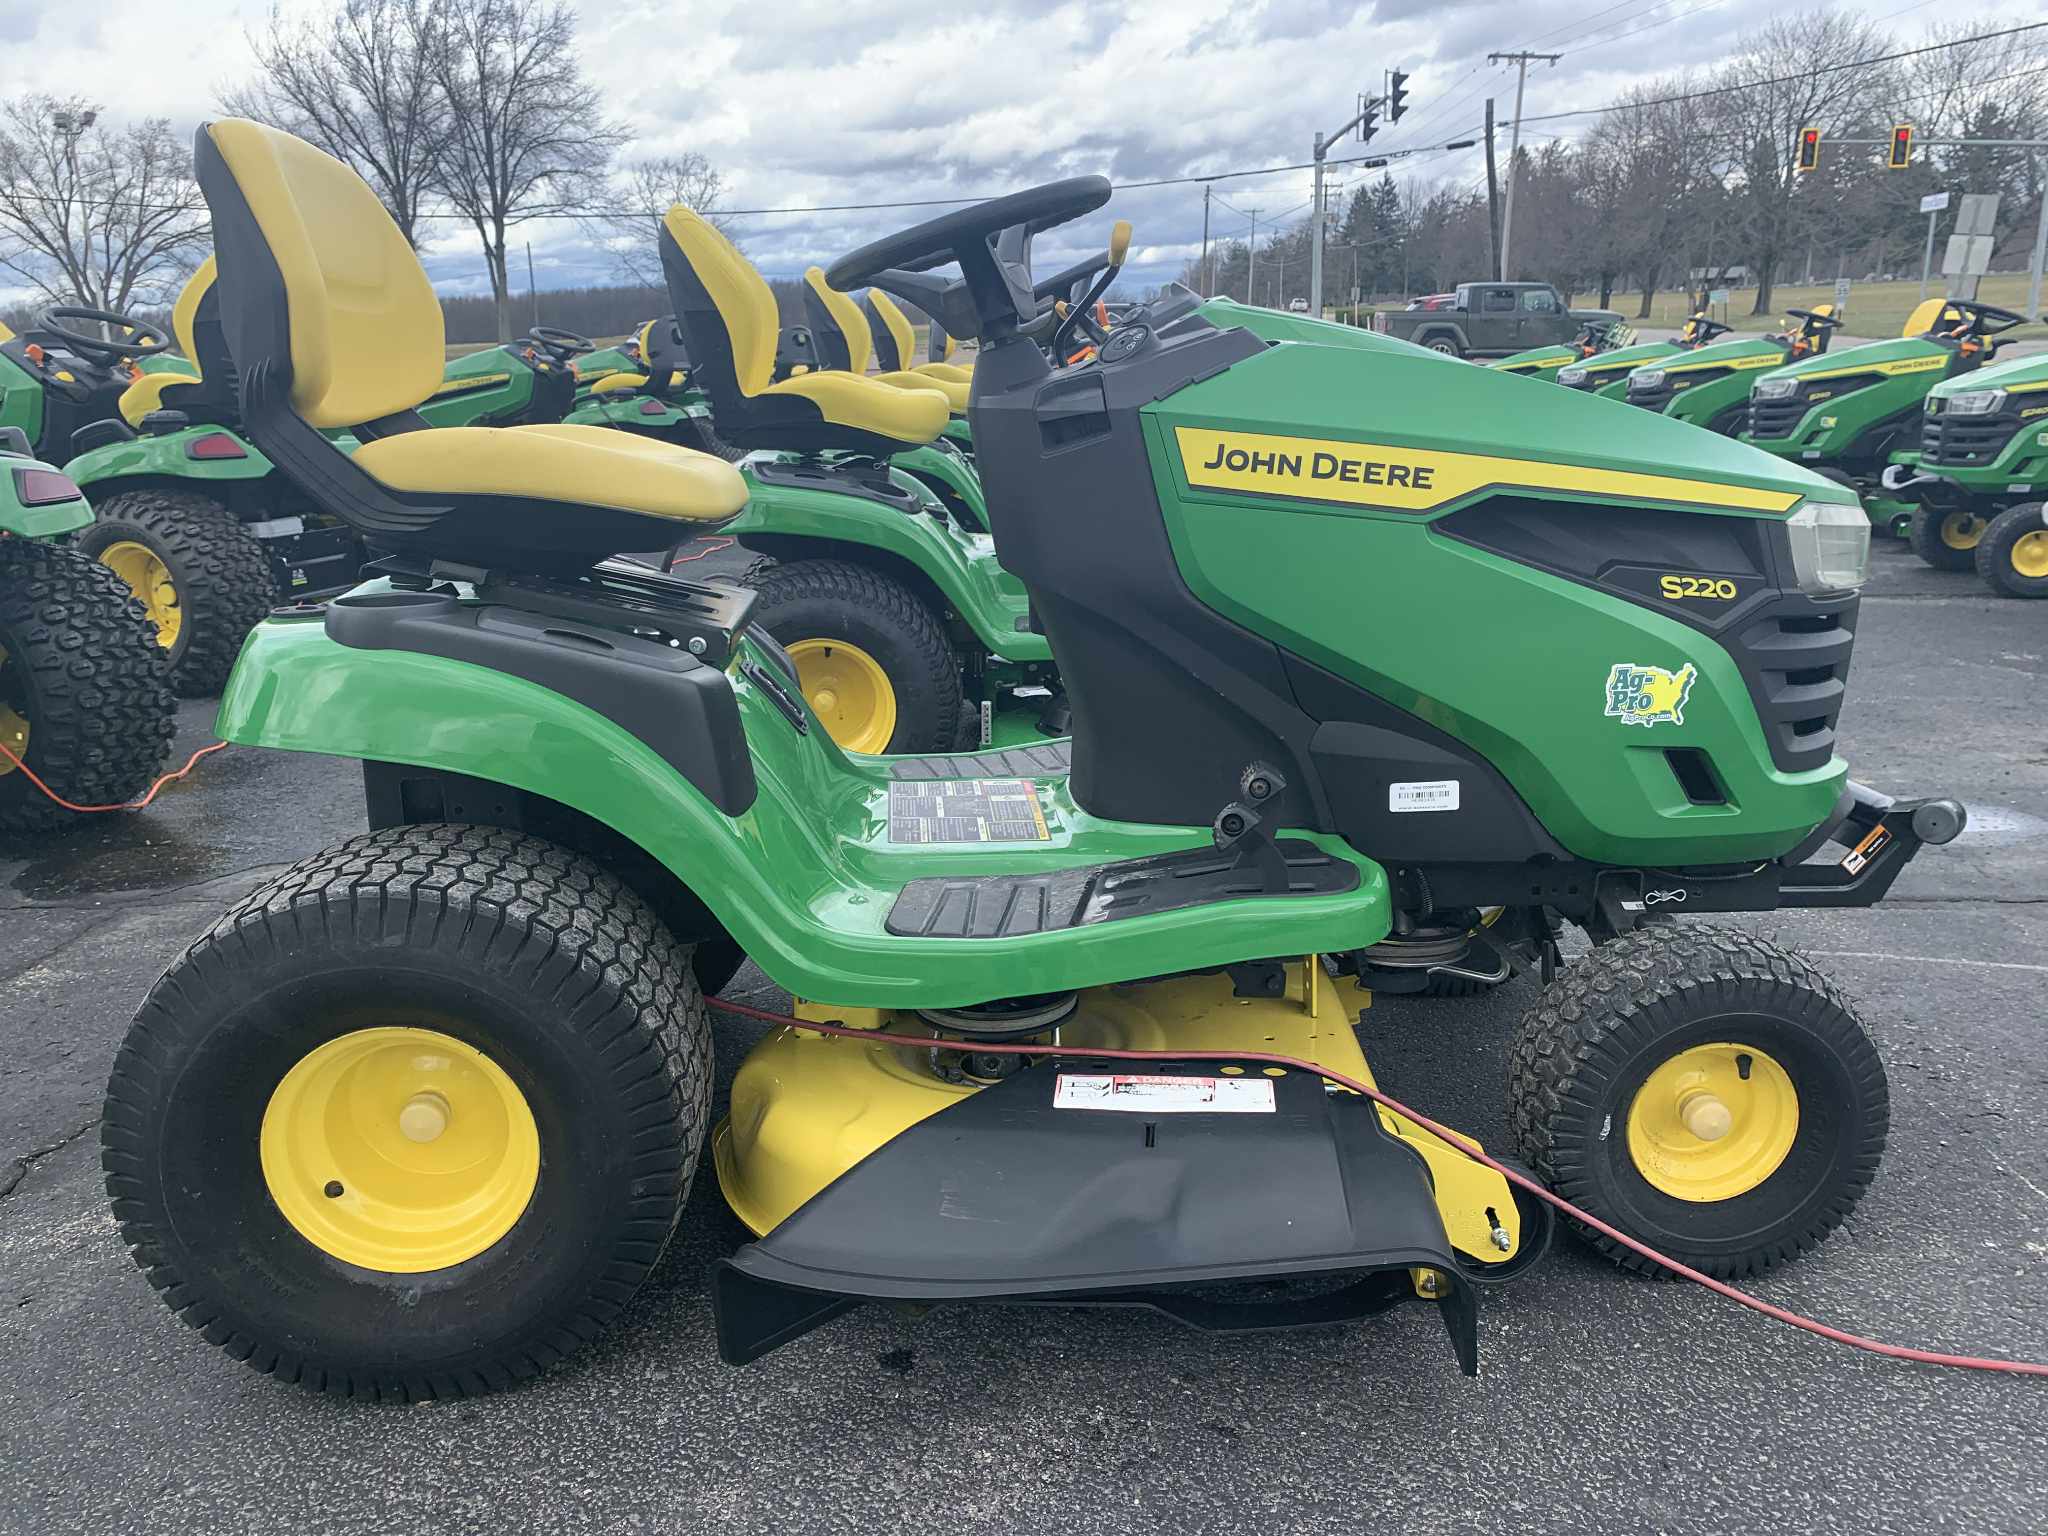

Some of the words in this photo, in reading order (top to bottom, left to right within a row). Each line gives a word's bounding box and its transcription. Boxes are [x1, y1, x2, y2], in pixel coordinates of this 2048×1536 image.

[1204, 443, 1303, 477] JOHN
[1311, 452, 1435, 490] DEERE
[1660, 575, 1737, 600] S220
[1608, 690, 1654, 712] Pro
[1142, 1076, 1202, 1085] DANGER
